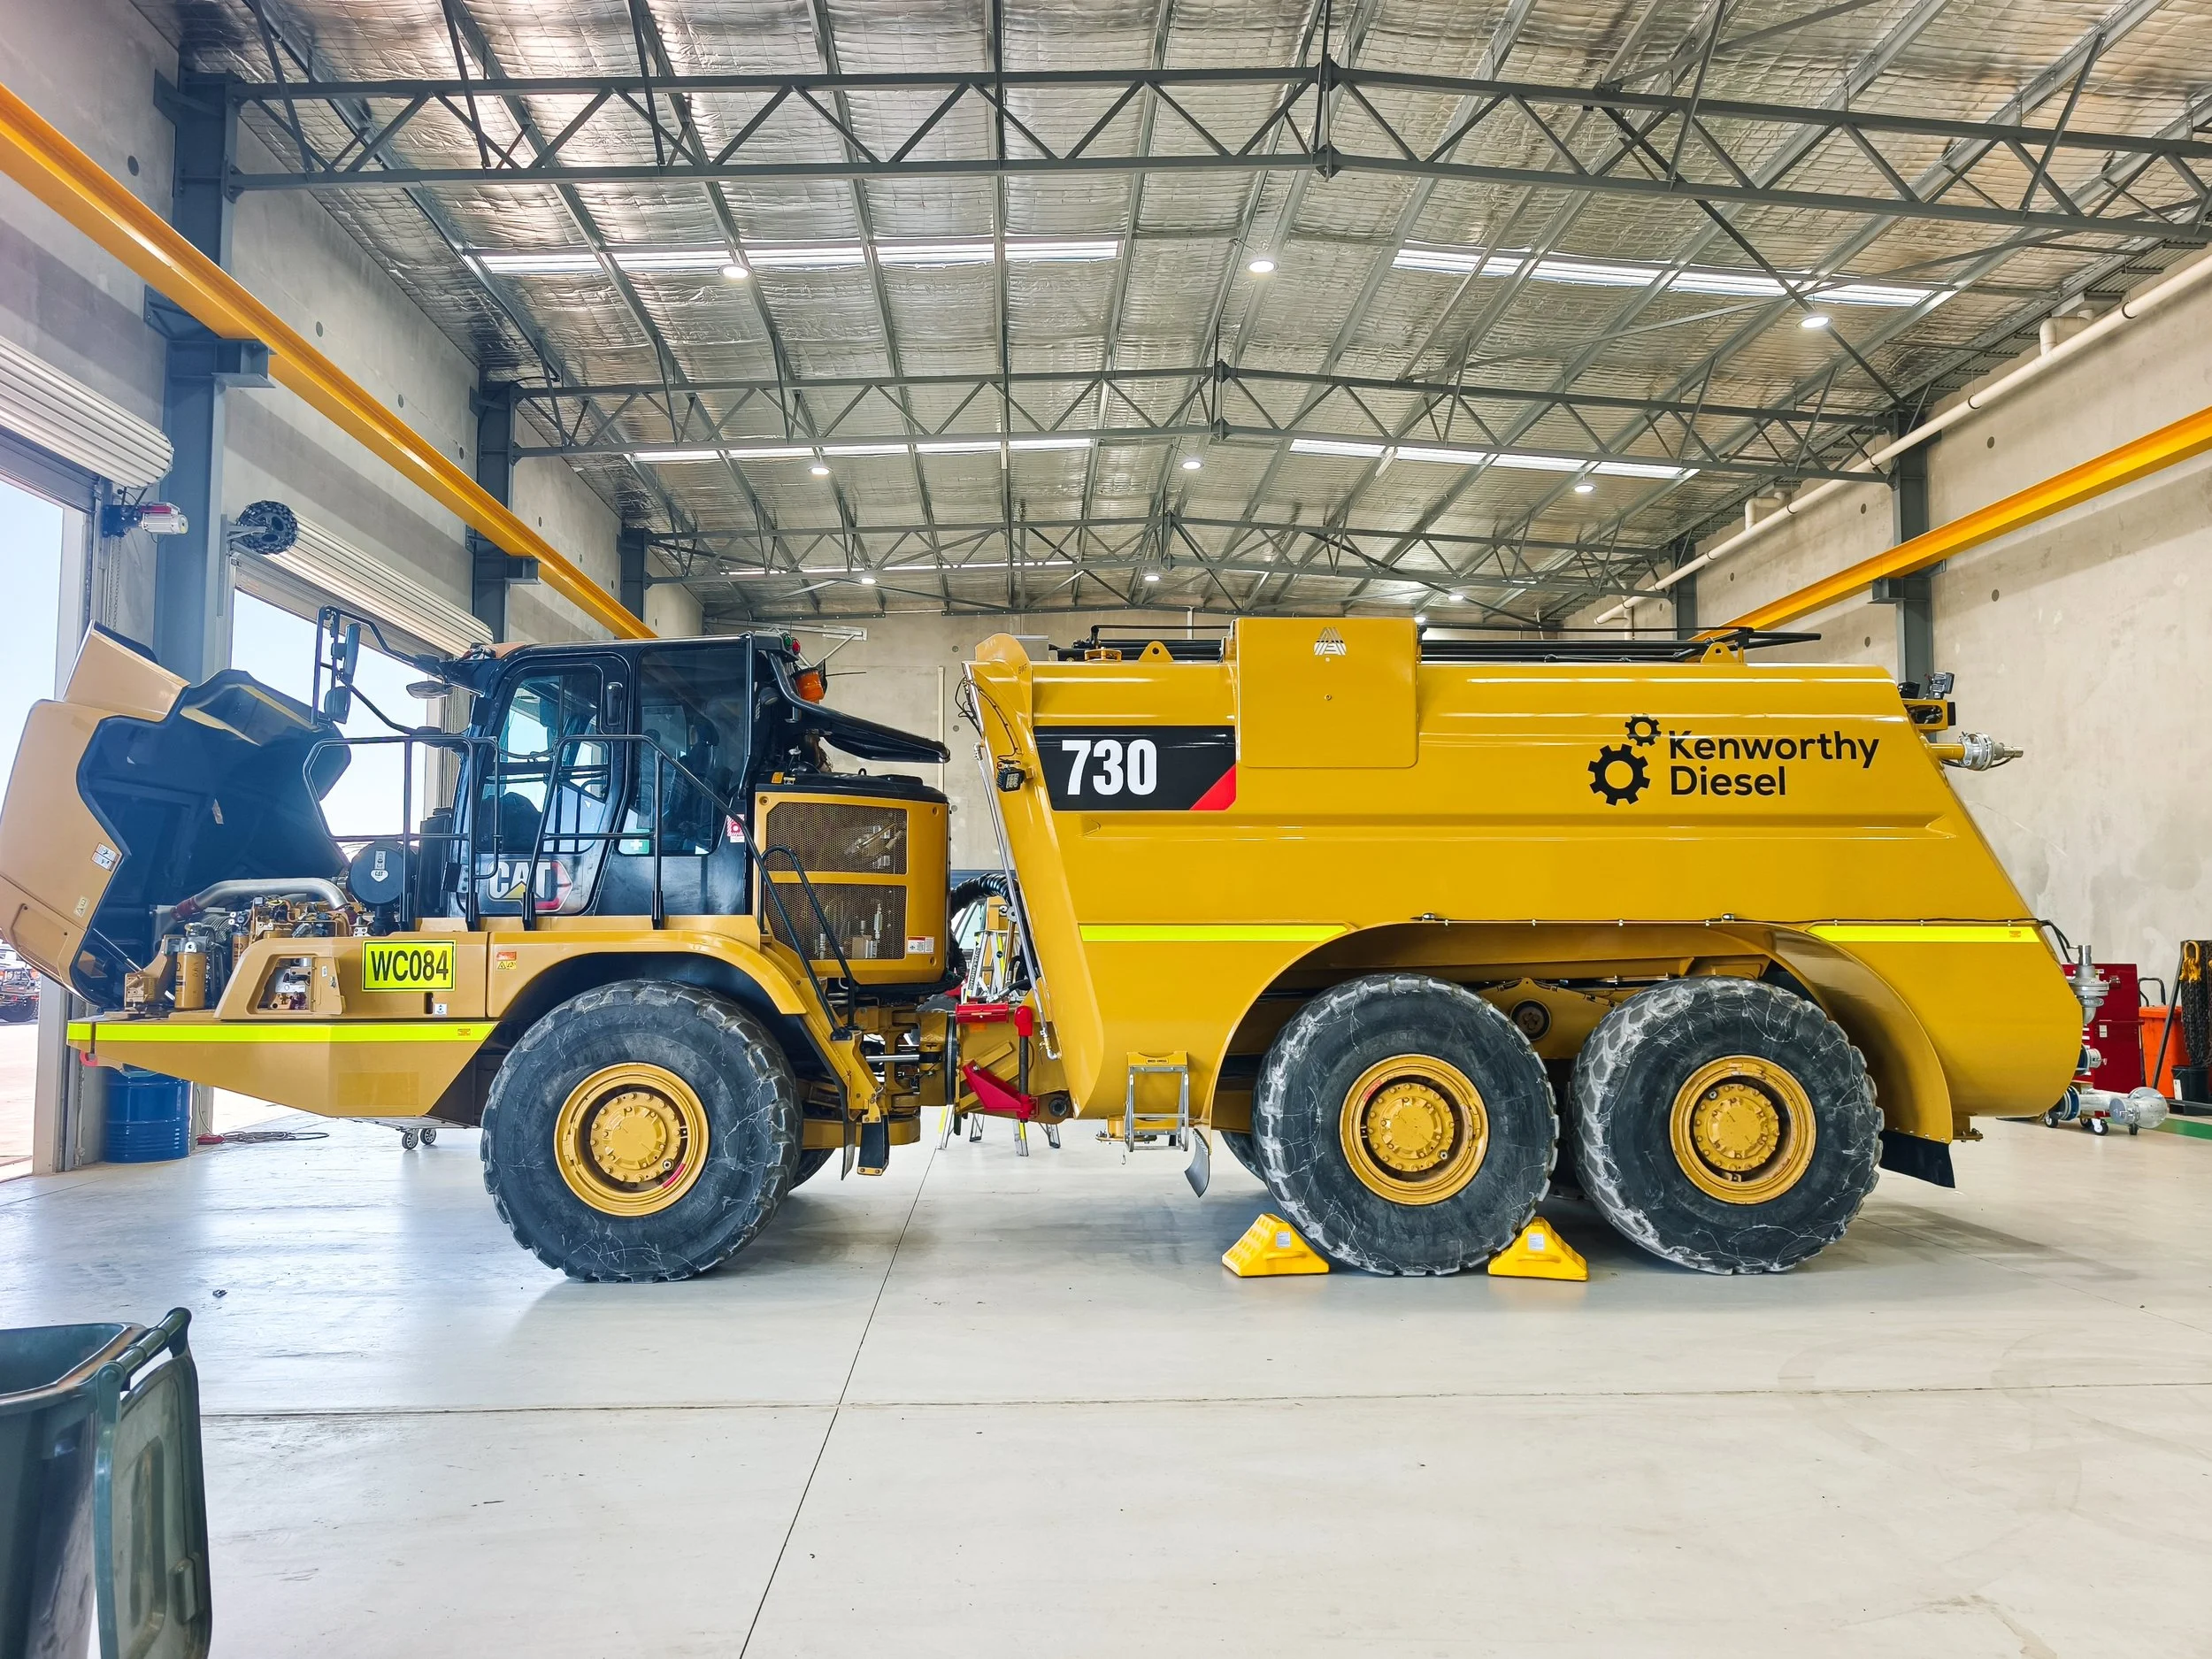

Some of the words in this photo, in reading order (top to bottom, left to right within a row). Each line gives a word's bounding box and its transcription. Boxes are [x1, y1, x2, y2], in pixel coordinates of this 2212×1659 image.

[1062, 739, 1157, 795] 730
[1669, 730, 1879, 769] Kenworthy
[1671, 765, 1786, 795] Diesel
[489, 862, 551, 899] CAT
[370, 949, 449, 981] WC084
